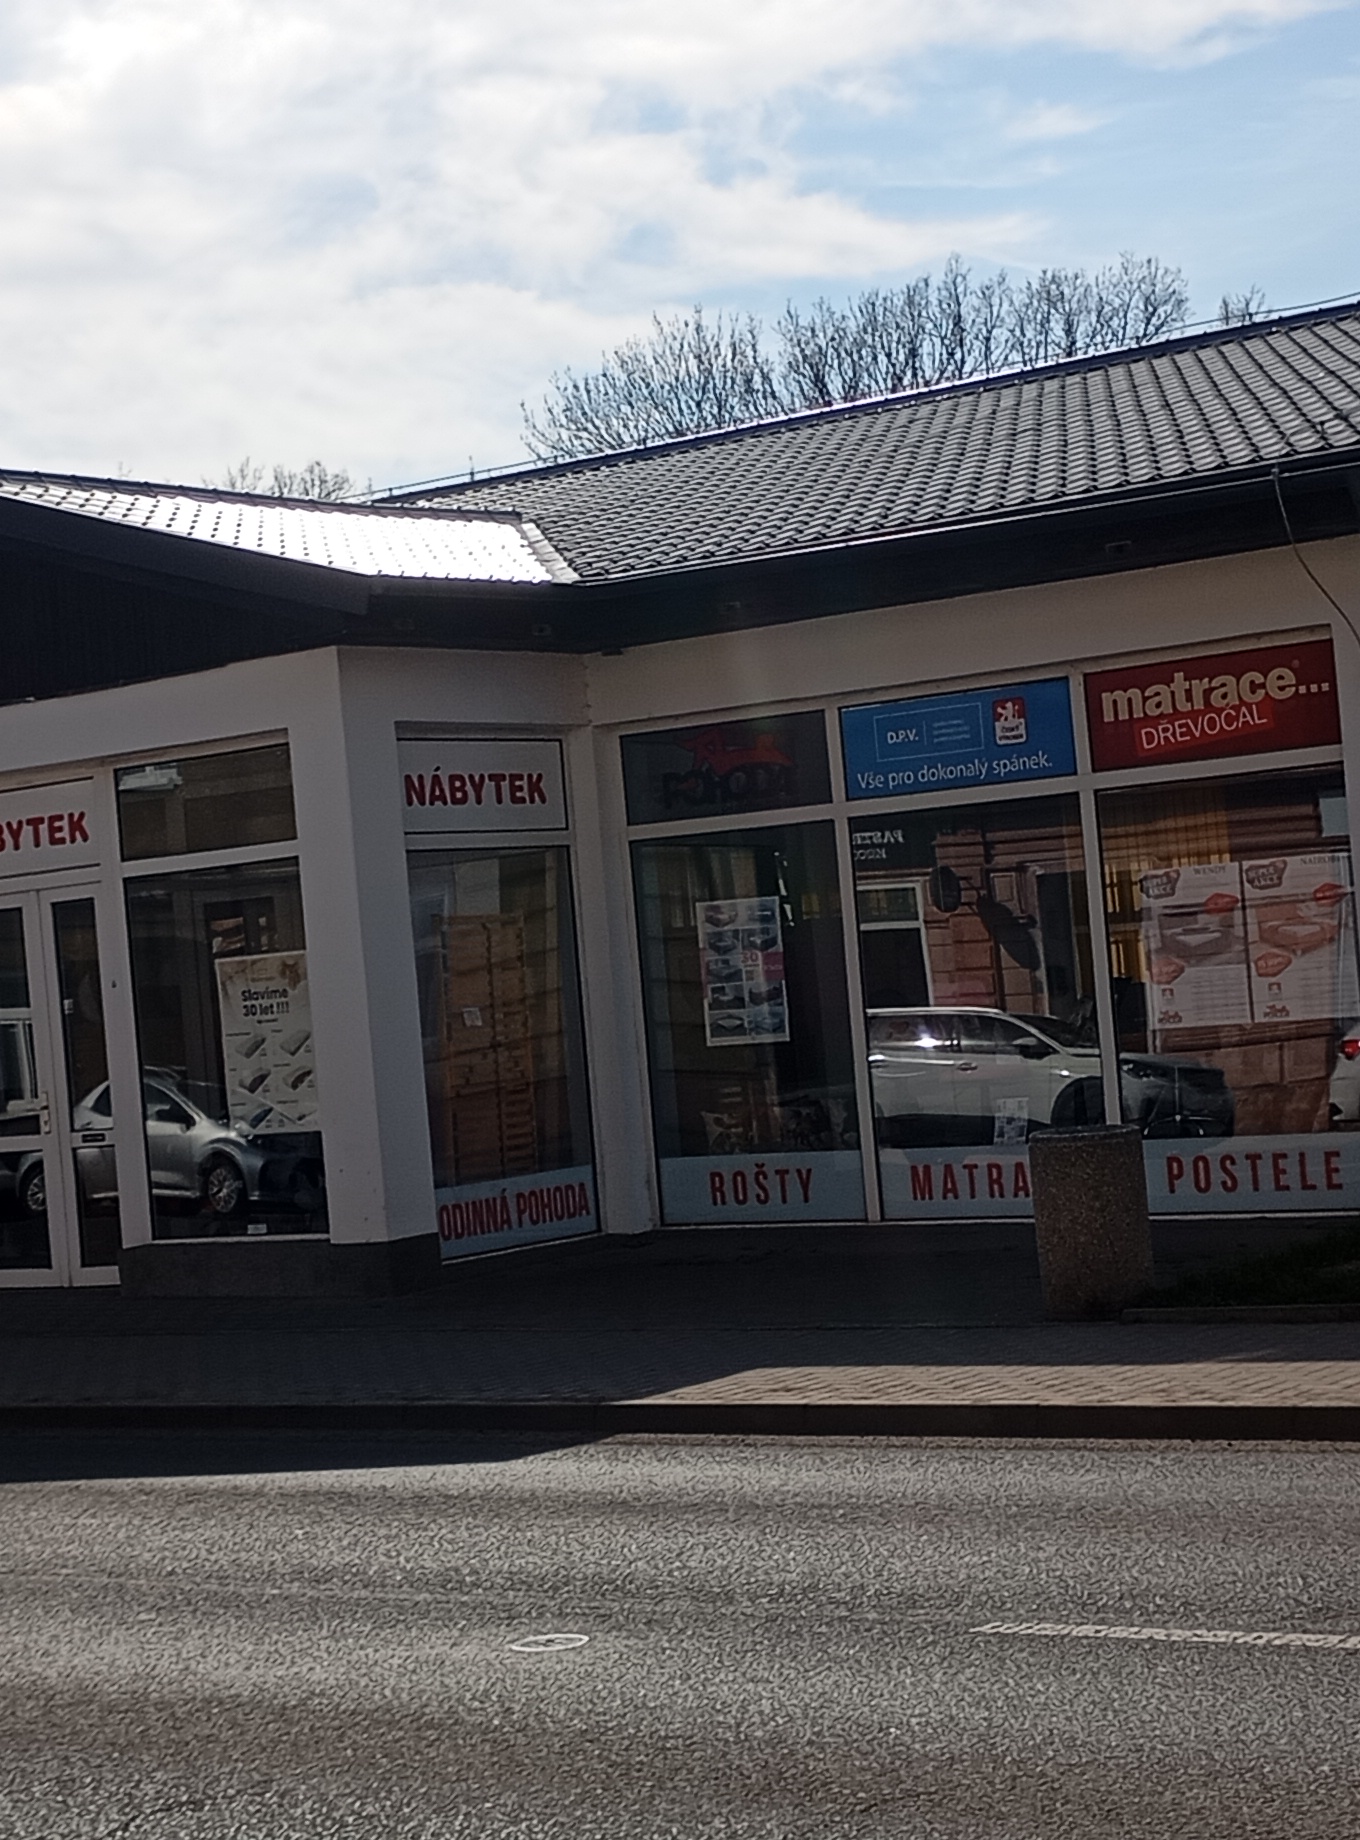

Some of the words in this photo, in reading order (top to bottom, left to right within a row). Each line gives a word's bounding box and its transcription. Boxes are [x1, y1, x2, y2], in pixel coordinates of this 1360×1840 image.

[887, 728, 919, 744] D.P.V.
[1141, 700, 1268, 749] DŘEVOČAL
[404, 766, 547, 806] NÁBYTEK
[857, 771, 884, 789] Vše
[888, 771, 914, 790] pro
[918, 758, 988, 782] dokonalý
[992, 750, 1053, 777] spánek.
[241, 986, 289, 1003] Slavíme
[243, 1004, 257, 1017] 30
[259, 1003, 274, 1016] let
[709, 1163, 812, 1206] ROŠTY
[910, 1161, 1030, 1201] MATRA
[1166, 1151, 1343, 1194] POSTELE
[440, 1188, 512, 1241] ODINNÁ
[516, 1182, 590, 1227] POHODA
